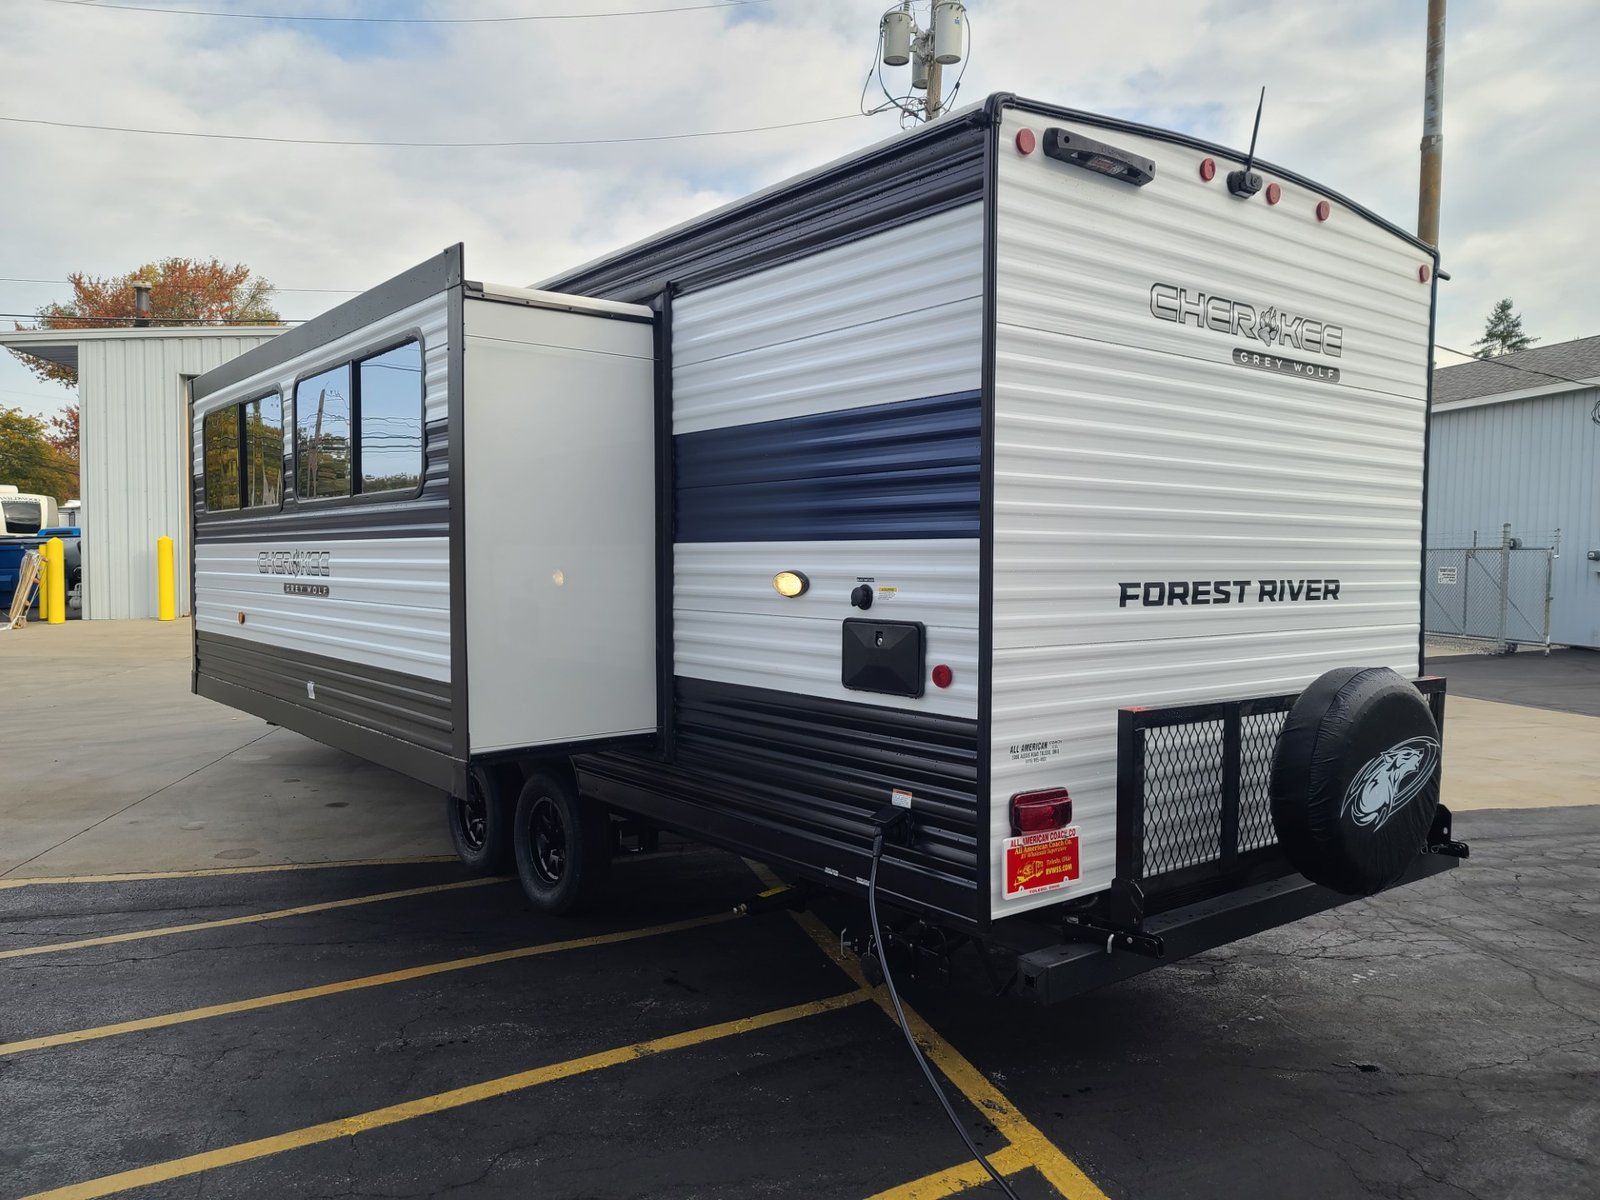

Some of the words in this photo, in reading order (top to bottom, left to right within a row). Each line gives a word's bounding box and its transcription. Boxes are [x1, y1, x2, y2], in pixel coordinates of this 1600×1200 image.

[1150, 282, 1343, 358] CHEROKEE
[1240, 351, 1284, 369] GREY
[1293, 361, 1335, 379] WOLF
[257, 550, 330, 577] CHEROKEE
[285, 584, 304, 593] GREY
[307, 586, 328, 595] WOLF
[1118, 580, 1252, 607] FOREST
[1258, 579, 1341, 602] RIVER
[1010, 744, 1019, 754] ALL
[1020, 741, 1048, 752] AMERICAN
[1010, 839, 1020, 848] ALL
[1068, 828, 1077, 837] CO
[1024, 843, 1048, 853] American
